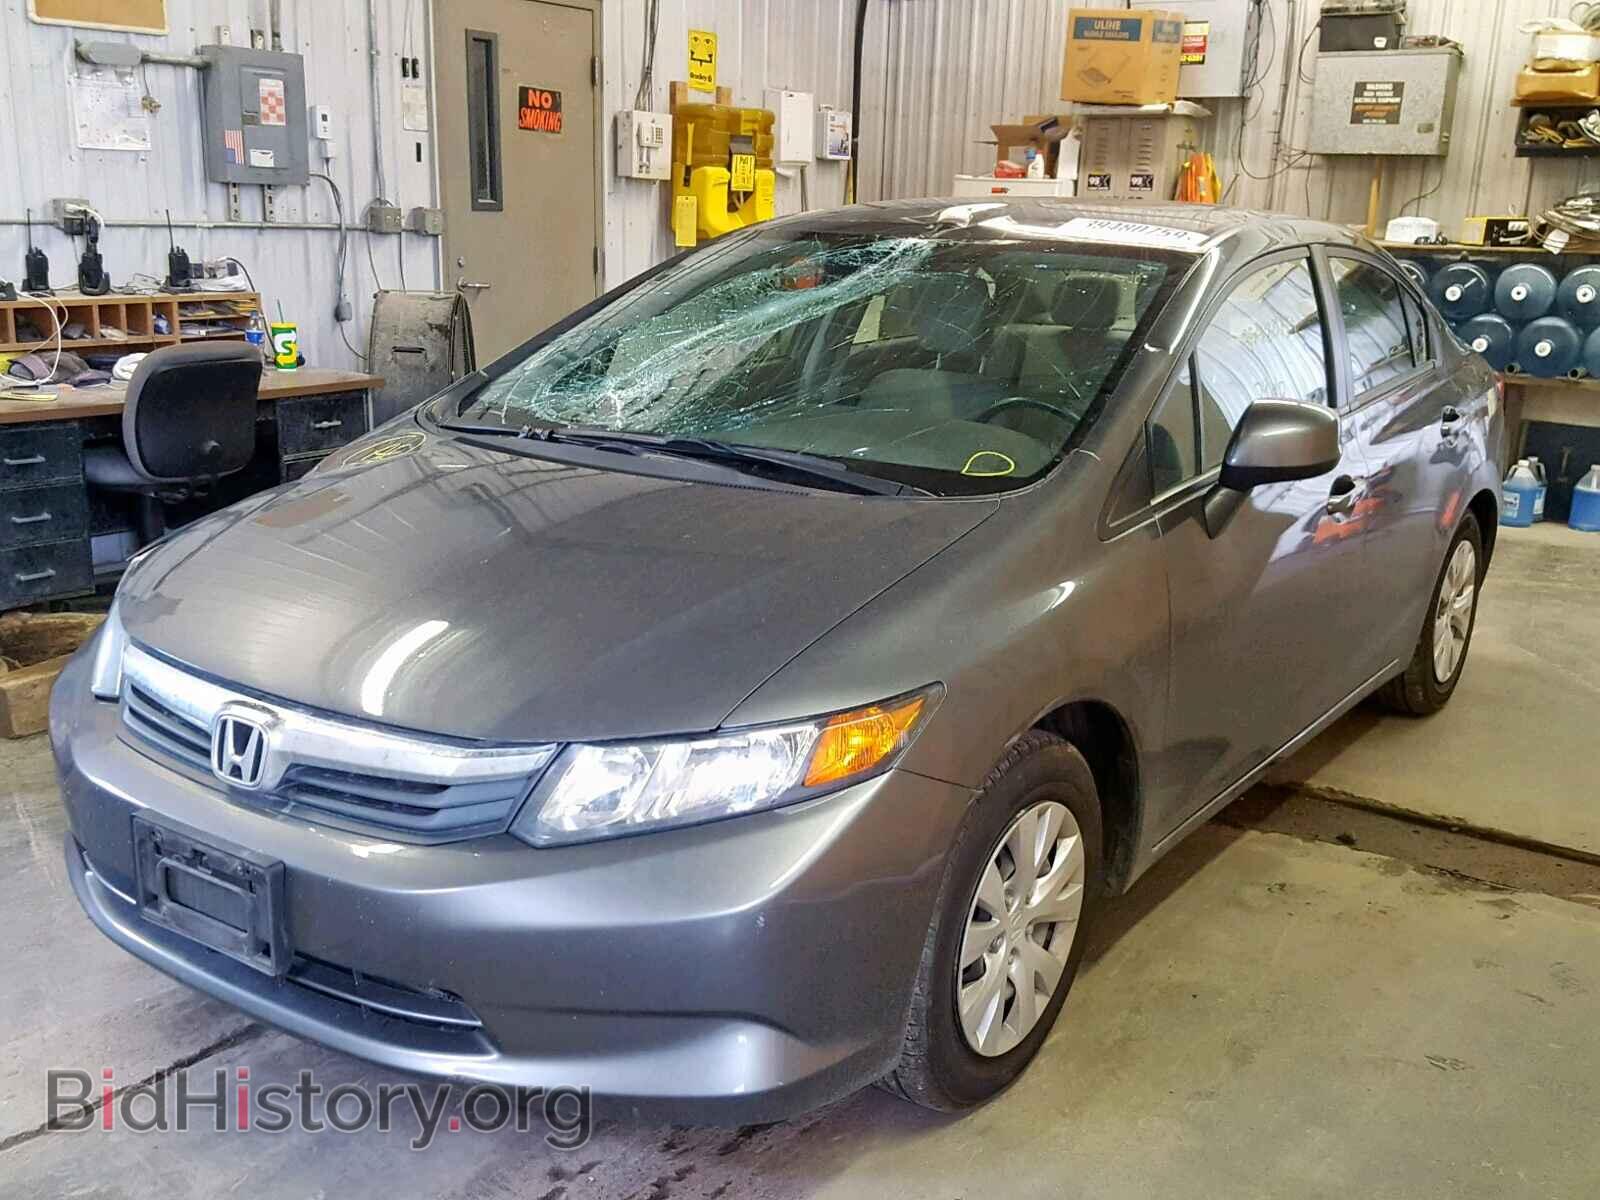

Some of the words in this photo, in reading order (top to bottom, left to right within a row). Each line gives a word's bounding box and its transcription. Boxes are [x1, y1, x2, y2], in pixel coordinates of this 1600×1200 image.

[1094, 19, 1121, 31] ULINE
[528, 89, 552, 108] NO
[520, 107, 561, 132] SMOKING
